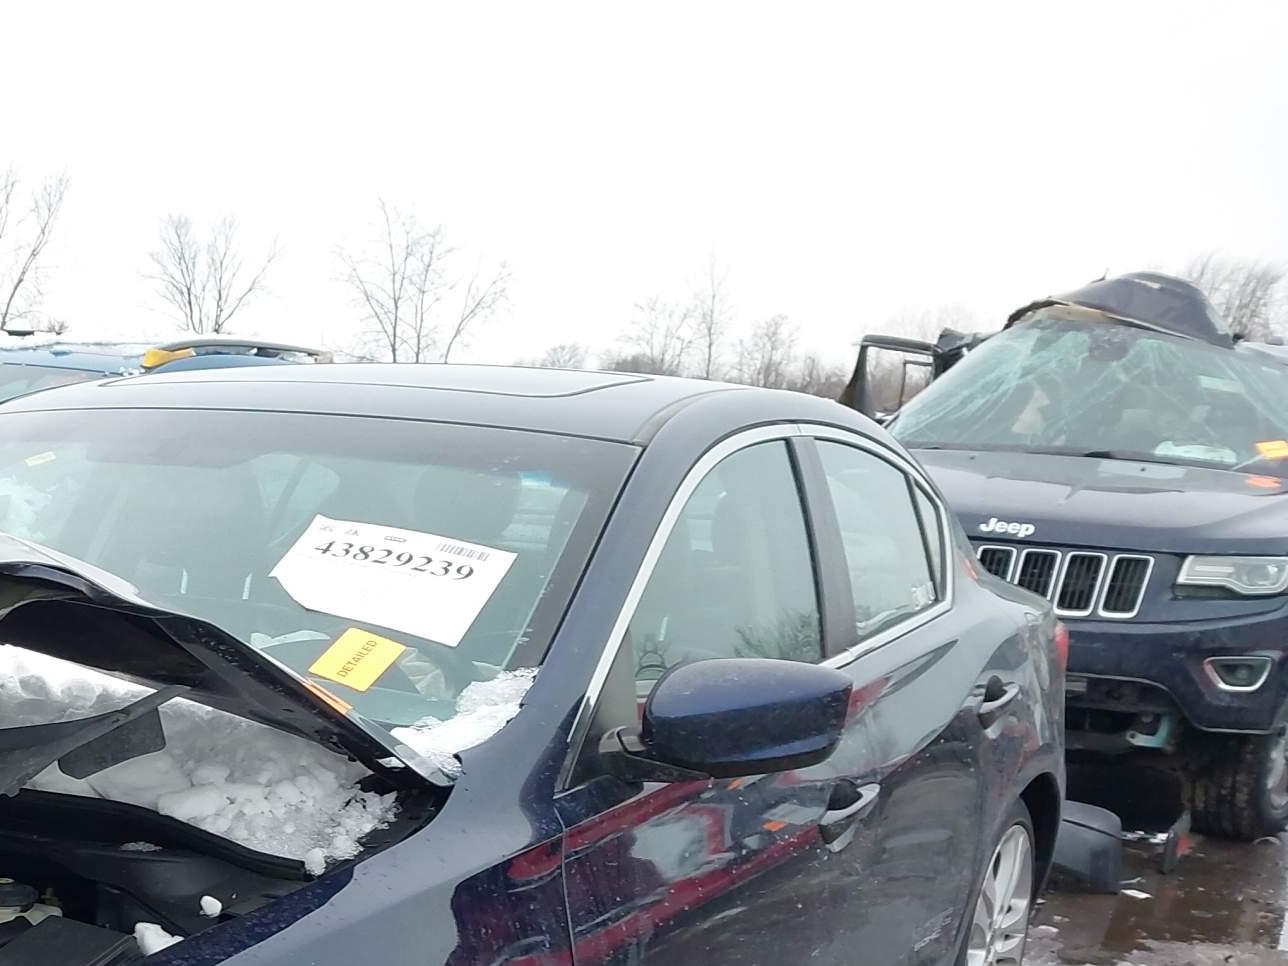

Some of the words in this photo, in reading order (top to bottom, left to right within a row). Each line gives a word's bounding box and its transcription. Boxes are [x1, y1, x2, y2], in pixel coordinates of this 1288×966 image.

[980, 518, 1035, 537] Jeep
[315, 541, 474, 580] 43829239
[336, 640, 377, 677] DETAILED
